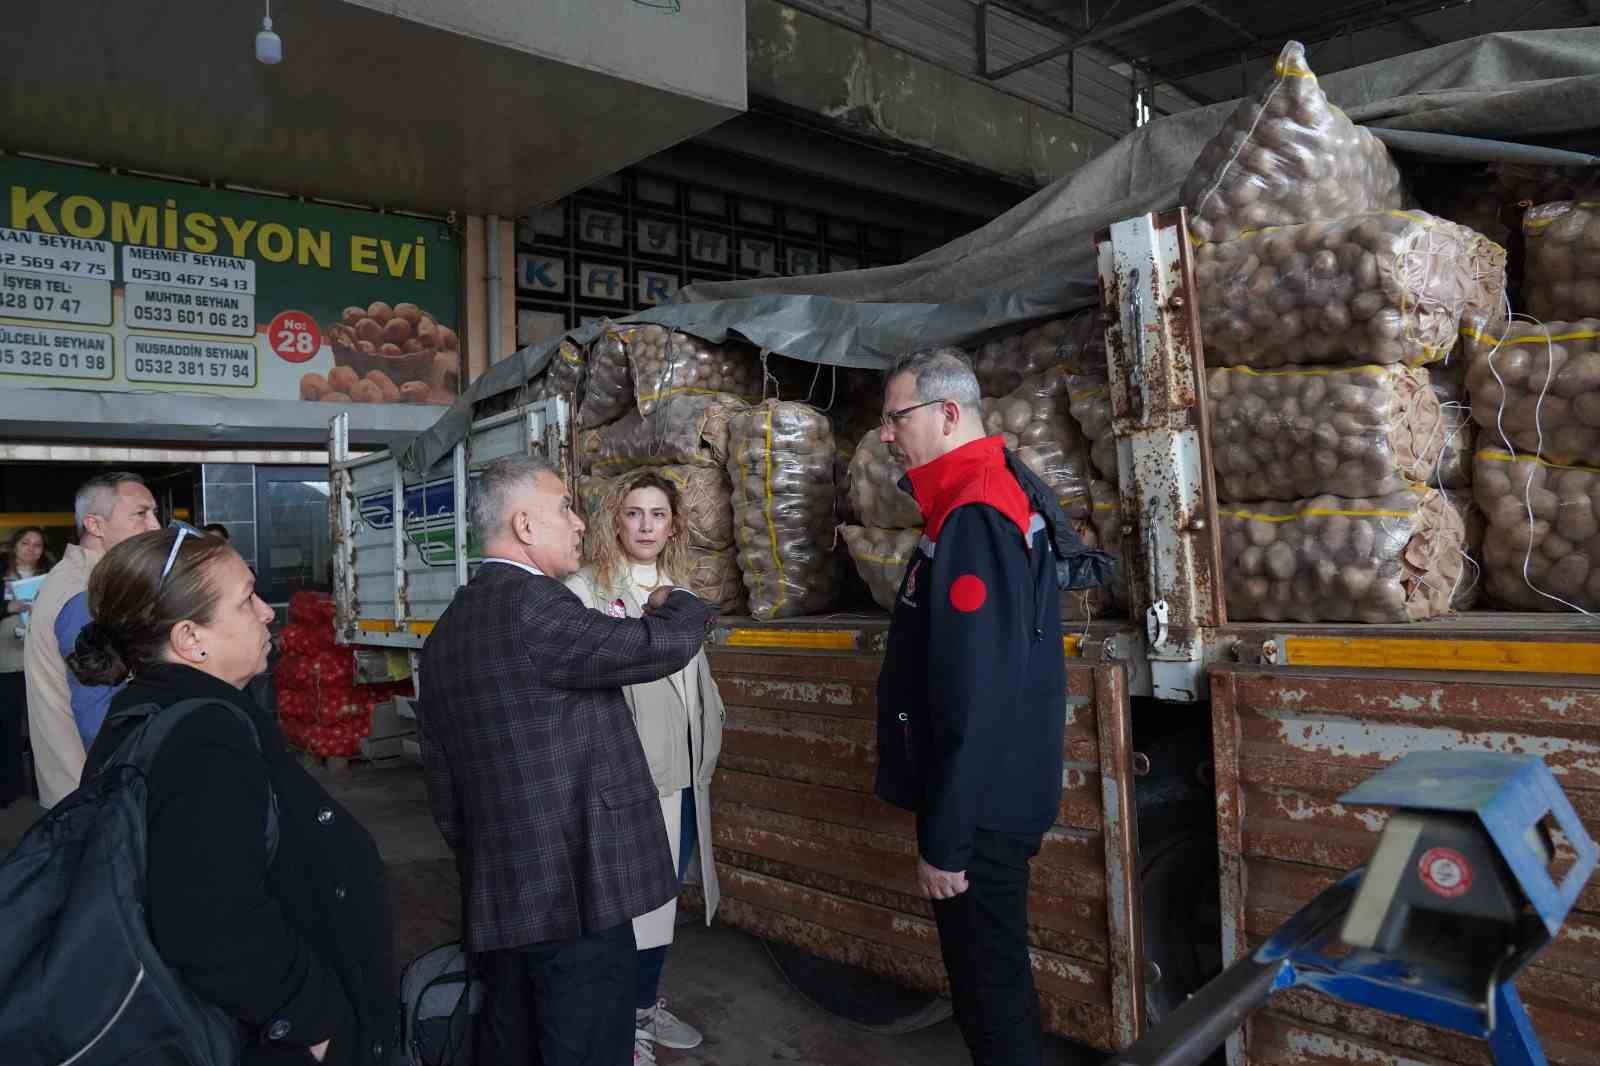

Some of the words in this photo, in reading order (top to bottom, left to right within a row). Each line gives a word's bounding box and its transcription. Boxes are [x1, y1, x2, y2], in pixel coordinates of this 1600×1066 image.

[10, 185, 331, 268] KOMİSYON
[351, 235, 426, 281] EVİ
[39, 234, 105, 253] SEYHAN
[0, 253, 15, 265] 2
[21, 255, 54, 270] 569
[60, 260, 81, 272] 47
[86, 262, 106, 275] 75
[129, 248, 187, 263] MEHMET
[193, 254, 247, 270] SEYHAN
[3, 271, 41, 291] İŞYER
[132, 268, 171, 282] 0530
[176, 273, 205, 286] 467
[210, 277, 229, 288] 54
[233, 280, 248, 290] 13
[34, 296, 54, 311] 07
[61, 299, 80, 314] 47
[145, 291, 192, 305] MUHTAR
[195, 295, 239, 309] SEYHAN
[134, 305, 172, 322] 0533
[177, 309, 203, 324] 601
[209, 312, 227, 326] 06
[232, 315, 249, 328] 23
[283, 319, 307, 331] No:
[54, 336, 105, 351] SEYHAN
[276, 330, 313, 353] 28
[0, 349, 14, 364] 5
[21, 351, 53, 367] 326
[59, 353, 78, 368] 01
[86, 355, 105, 370] 98
[206, 347, 249, 361] SEYHAN
[135, 358, 172, 374] 0532
[178, 361, 204, 376] 381
[210, 363, 227, 377] 57
[232, 364, 249, 378] 94
